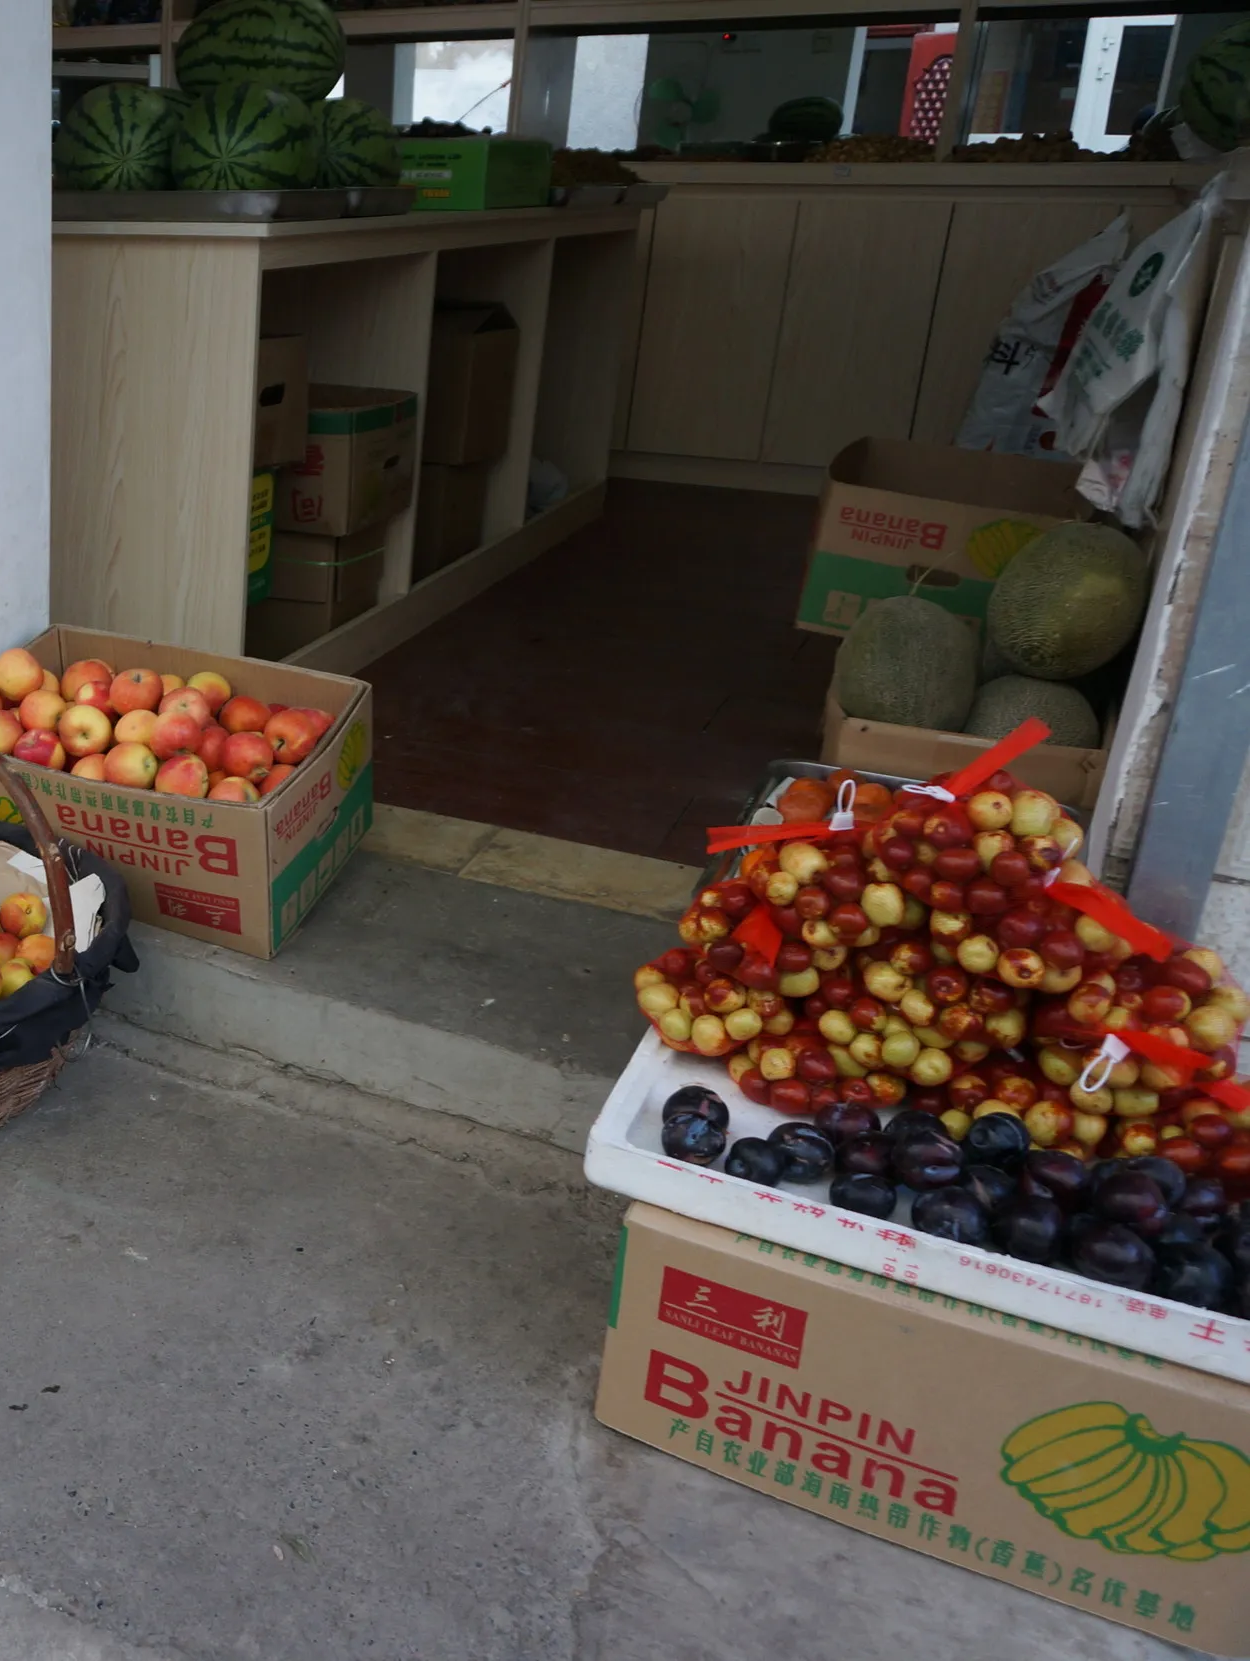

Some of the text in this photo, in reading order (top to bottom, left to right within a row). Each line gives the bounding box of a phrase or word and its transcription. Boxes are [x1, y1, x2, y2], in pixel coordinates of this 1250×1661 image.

[840, 506, 948, 551] Banana
[851, 528, 914, 551] JINPIN
[56, 803, 239, 877] Banana
[85, 839, 191, 876] JINPIN
[959, 1255, 1103, 1308] 18717430616
[664, 1308, 798, 1363] SANLI LEAF BANANAS
[685, 1285, 787, 1340] 三利
[644, 1348, 959, 1517] Banana
[723, 1370, 916, 1455] JINPIN
